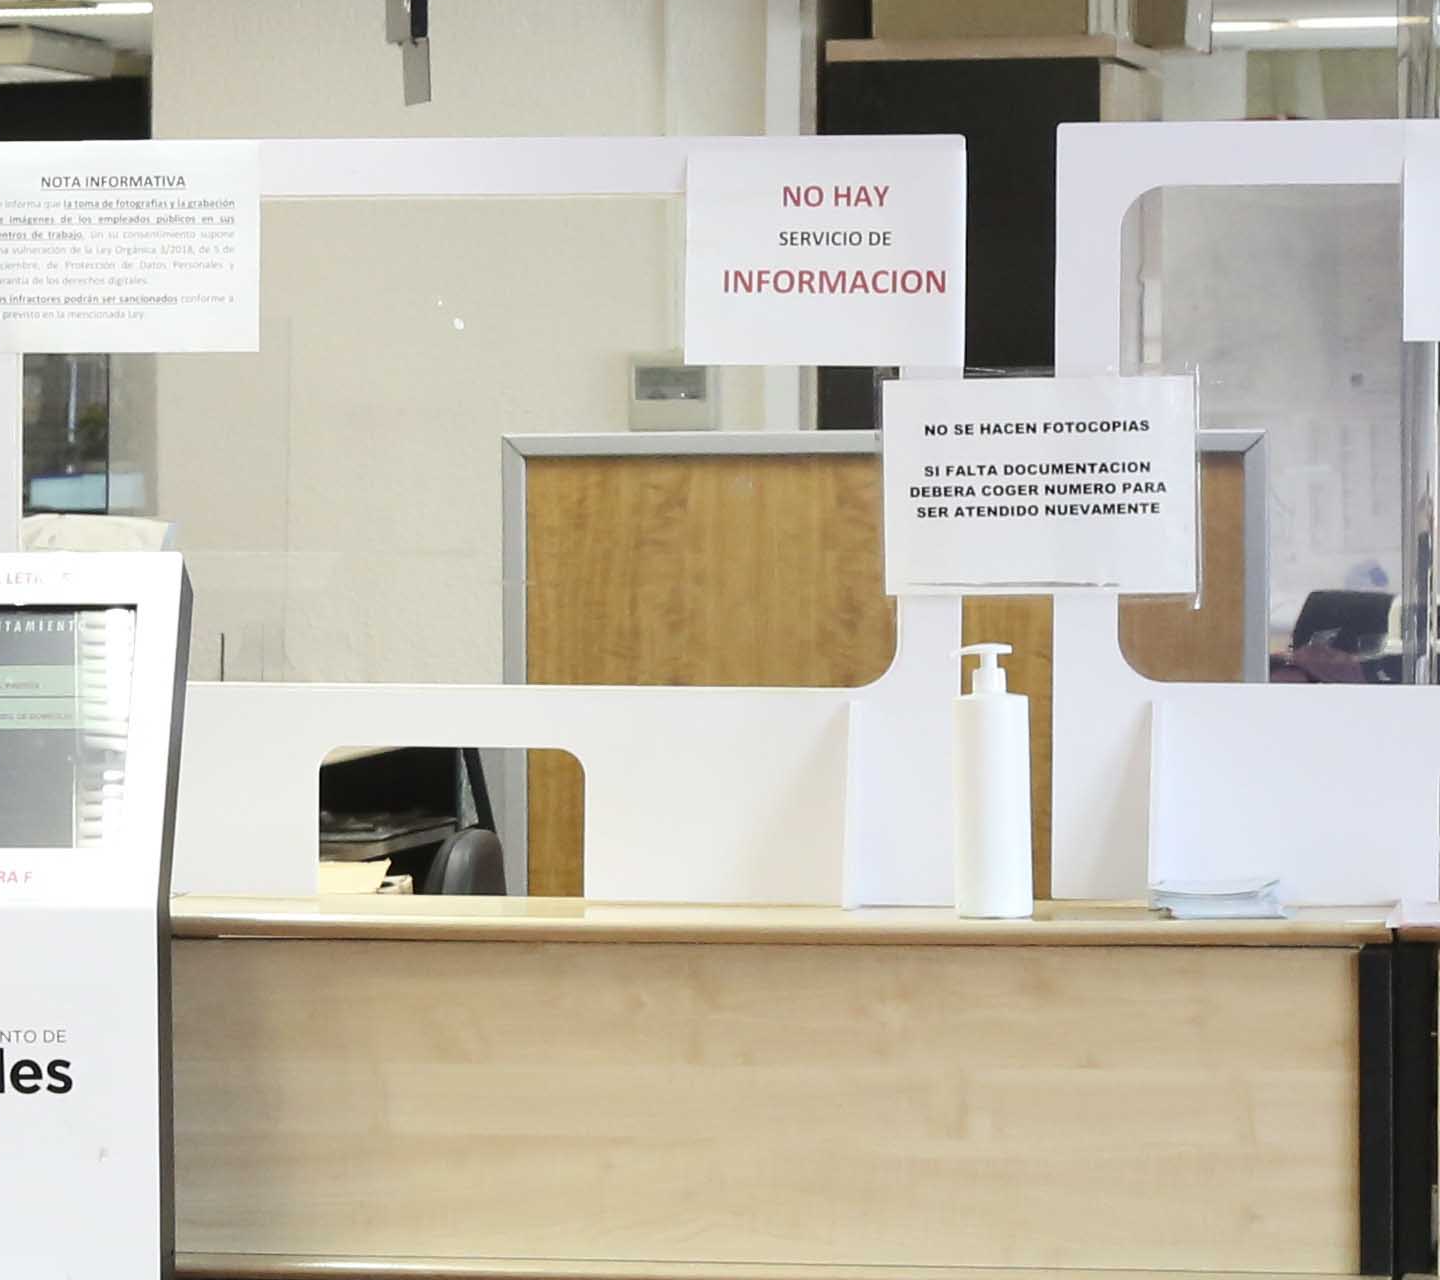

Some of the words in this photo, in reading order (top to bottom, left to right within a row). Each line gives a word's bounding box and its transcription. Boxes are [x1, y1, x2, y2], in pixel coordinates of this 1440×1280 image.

[40, 176, 81, 188] NOTA
[85, 175, 186, 188] INFORMATIVA
[782, 185, 824, 208] NO
[833, 185, 890, 207] HAY
[63, 199, 72, 208] la
[74, 199, 99, 208] toma
[101, 199, 113, 208] de
[169, 200, 175, 210] y
[177, 199, 186, 208] la
[187, 199, 235, 210] grabación
[9, 215, 54, 226] imágenes
[60, 215, 72, 224] de
[78, 215, 92, 224] los
[98, 215, 150, 226] empleados
[156, 215, 196, 226] públicos
[201, 216, 214, 224] en
[219, 216, 235, 224] sus
[31, 231, 44, 240] de
[778, 231, 863, 247] SERVICIO
[868, 231, 893, 246] DE
[723, 269, 947, 294] INFORMACION
[9, 294, 61, 304] infractores
[64, 294, 99, 306] podrán
[102, 296, 116, 304] ser
[119, 294, 178, 304] sancionados
[923, 424, 949, 437] NO
[953, 423, 975, 436] SE
[979, 421, 1038, 436] HACEN
[1042, 419, 1150, 435] FOTOCOPIAS
[923, 464, 940, 478] SI
[945, 464, 998, 477] FALTA
[1003, 461, 1151, 476] DOCUMENTACION
[909, 485, 977, 499] DEBERA
[980, 483, 1040, 497] COGER
[1044, 482, 1117, 496] NUMERO
[1121, 481, 1167, 494] PARA
[916, 506, 949, 519] SER
[954, 504, 1039, 518] ATENDIDO
[1044, 502, 1161, 517] NUEVAMENTE
[23, 871, 34, 884] F
[42, 1029, 67, 1043] DE
